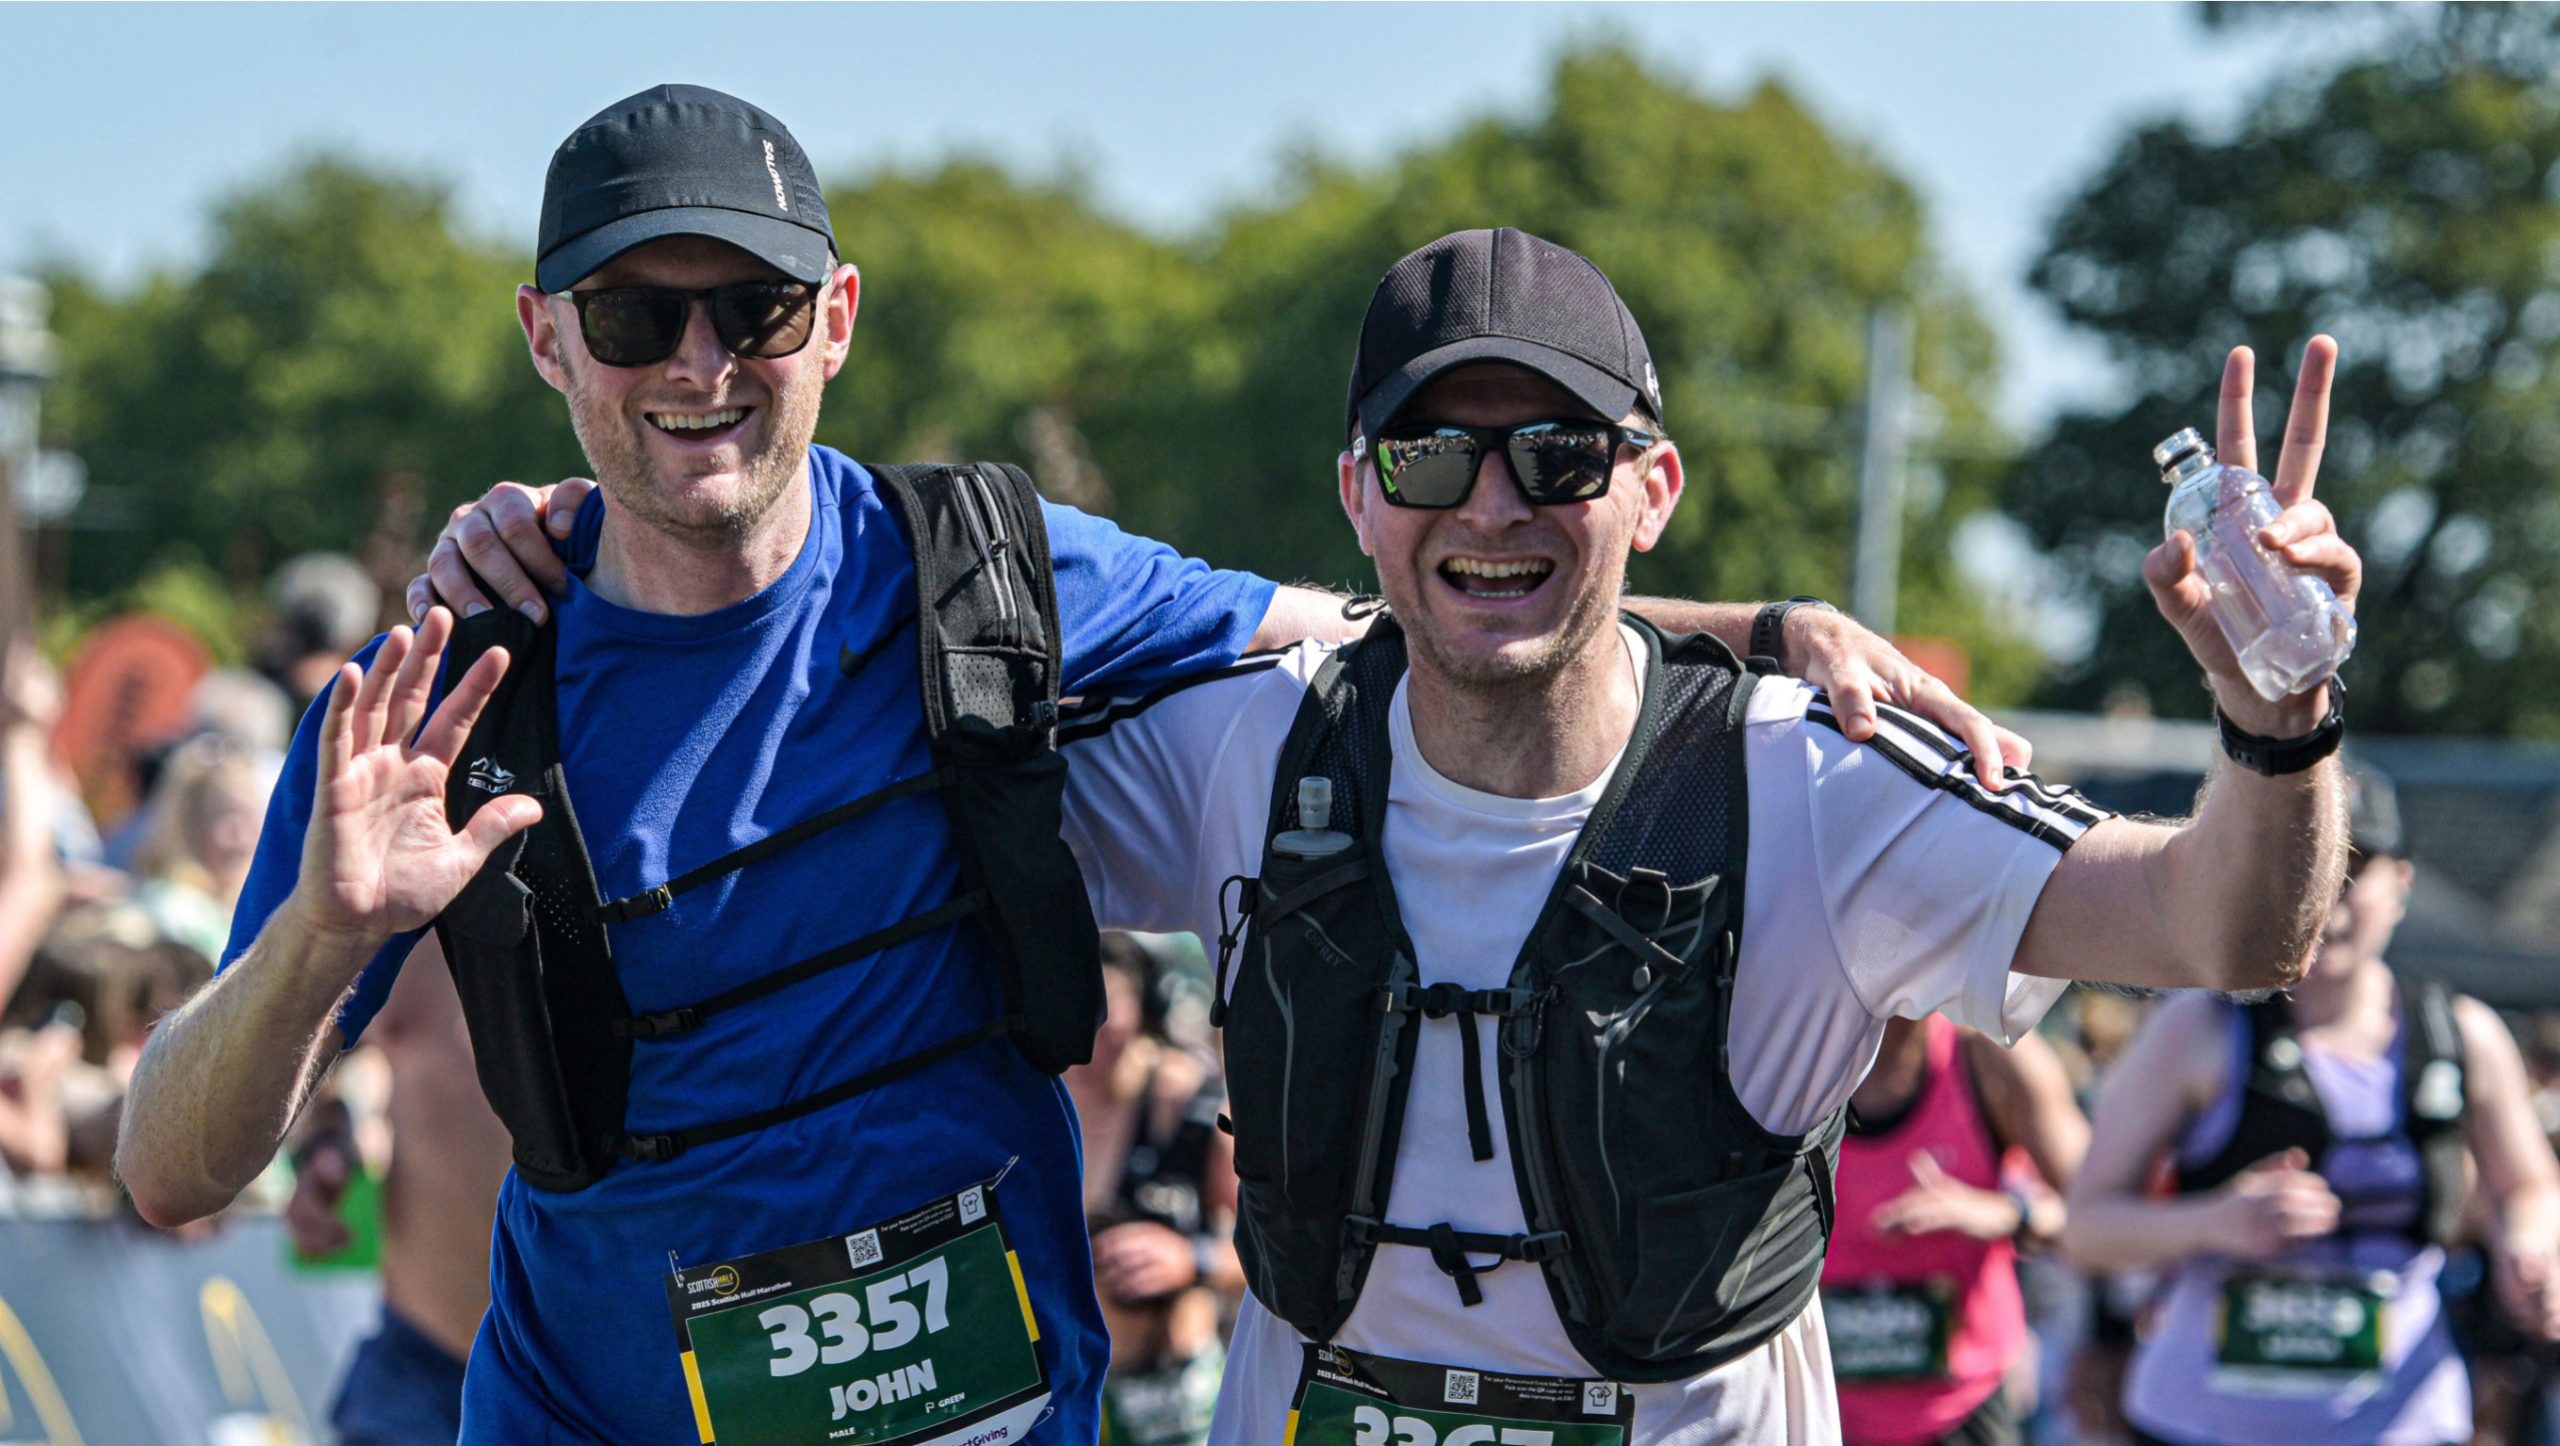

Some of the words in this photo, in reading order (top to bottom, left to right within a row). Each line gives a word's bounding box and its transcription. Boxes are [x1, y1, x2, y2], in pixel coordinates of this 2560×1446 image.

[763, 140, 788, 212] SALOMON
[691, 1300, 711, 1310] 2025
[711, 1293, 741, 1306] Scottish
[741, 1287, 756, 1299] Half
[756, 1280, 792, 1295] Marathon
[758, 1255, 950, 1377] 3357
[829, 1358, 938, 1421] JOHN
[938, 1392, 965, 1408] GREEN
[829, 1427, 856, 1439] MALE
